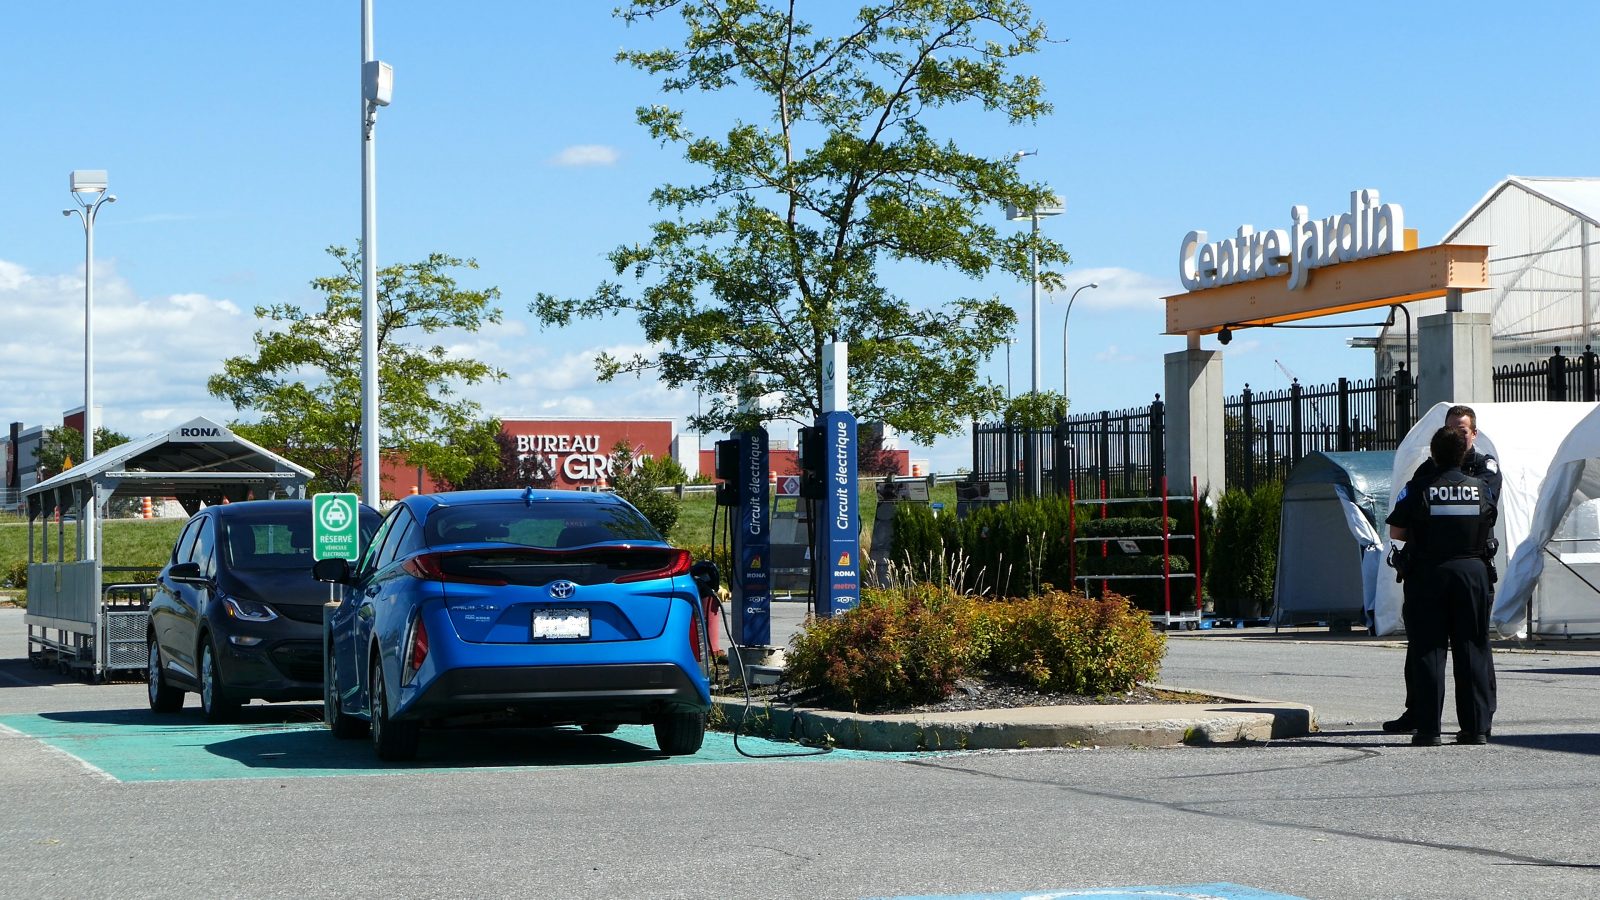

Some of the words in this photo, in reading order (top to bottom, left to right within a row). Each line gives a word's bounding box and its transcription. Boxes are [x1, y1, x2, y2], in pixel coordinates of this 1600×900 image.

[1180, 224, 1290, 292] Centre
[1287, 188, 1404, 291] jardin
[180, 427, 221, 437] RONA
[516, 434, 600, 452] BUREAU
[749, 435, 762, 494] électrique
[836, 421, 850, 485] électrique
[836, 488, 849, 530] Circuit
[1429, 486, 1480, 501] POLICE
[749, 497, 761, 535] Circuit
[320, 533, 353, 543] RÉSERVÉ
